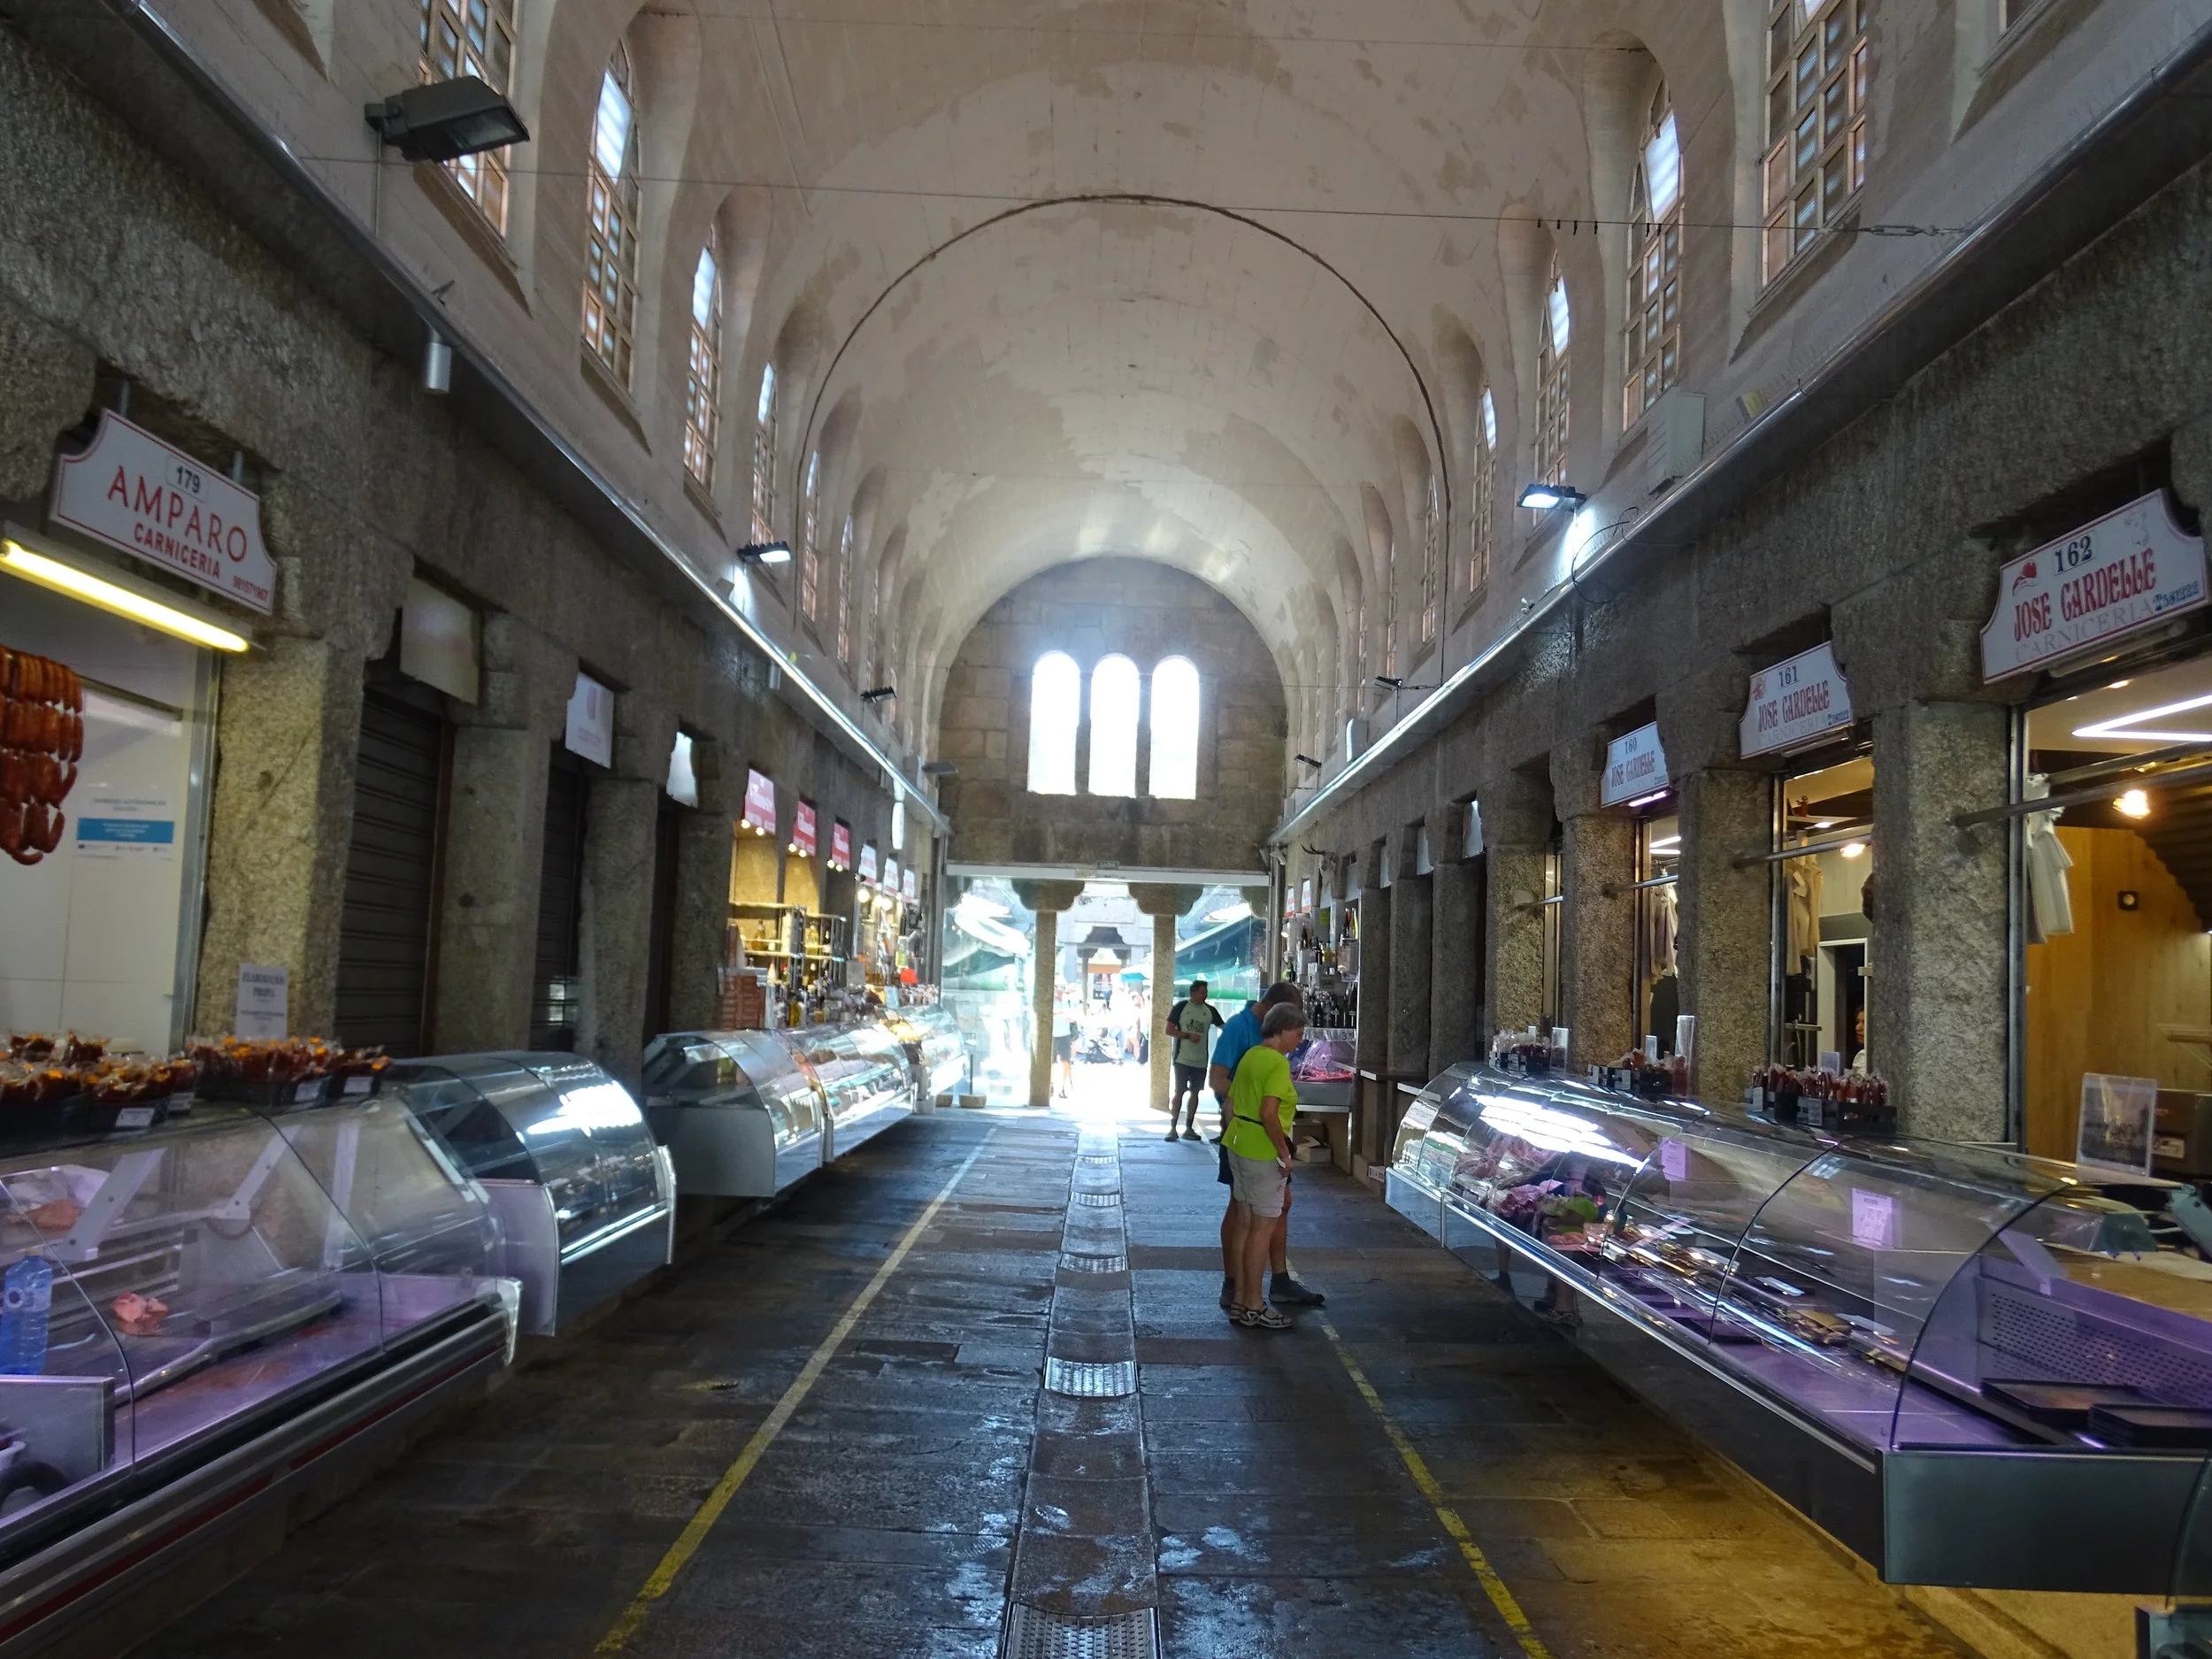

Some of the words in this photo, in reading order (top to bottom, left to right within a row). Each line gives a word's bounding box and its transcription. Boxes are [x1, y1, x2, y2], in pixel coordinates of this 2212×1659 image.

[177, 465, 201, 494] 179
[108, 465, 247, 563] AMPARO
[134, 522, 220, 577] CARNICERIA
[2055, 535, 2093, 573] 162
[2014, 591, 2053, 641] JOSE
[2060, 547, 2156, 622] GARDELLE
[2016, 597, 2155, 663] CARNICERIA
[1778, 664, 1798, 687] 161
[1757, 699, 1778, 733] JOSE
[1782, 679, 1830, 724] GARDELLE
[1624, 736, 1638, 755] 160
